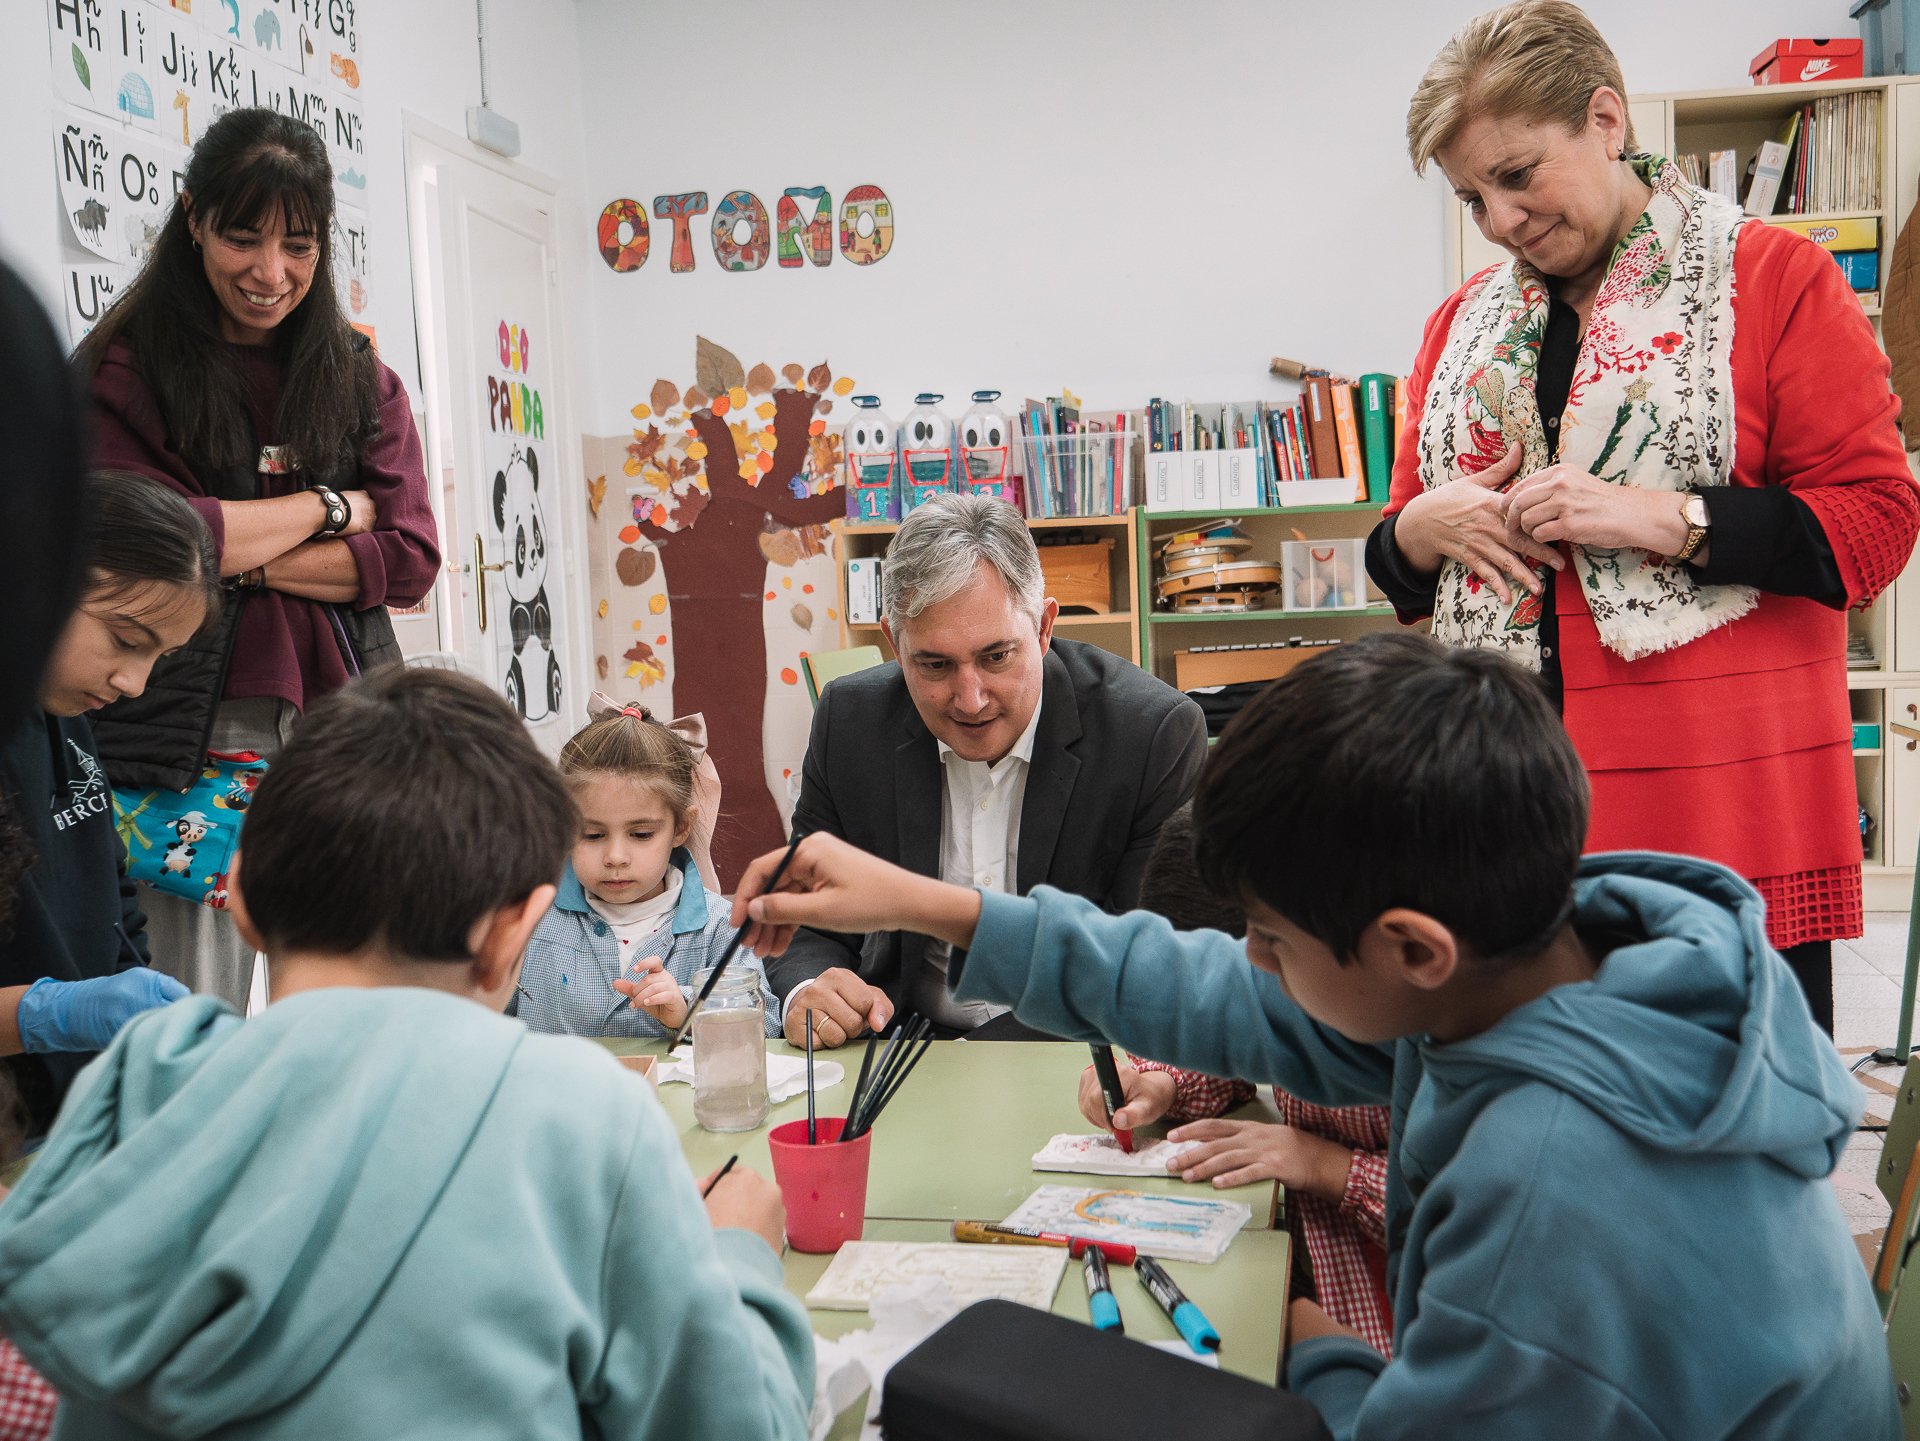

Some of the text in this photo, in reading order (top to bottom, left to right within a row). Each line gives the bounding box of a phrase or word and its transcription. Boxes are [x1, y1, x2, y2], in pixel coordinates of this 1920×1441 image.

[86, 17, 101, 52] h
[162, 31, 178, 75] J
[208, 50, 229, 100] K
[230, 79, 240, 108] k
[1805, 58, 1831, 72] NIKE
[335, 107, 352, 150] N
[62, 124, 88, 188] Ñ
[92, 163, 105, 192] ñ
[120, 153, 145, 202] O
[348, 228, 359, 268] T
[597, 185, 895, 274] OTOÑO
[72, 270, 99, 321] U
[498, 320, 529, 375] OSO
[487, 375, 544, 440] PANDA
[1158, 467, 1167, 496] CUENTOS
[1195, 465, 1204, 494] CUENTOS
[1232, 461, 1240, 491] CUENTOS
[864, 490, 881, 517] 1
